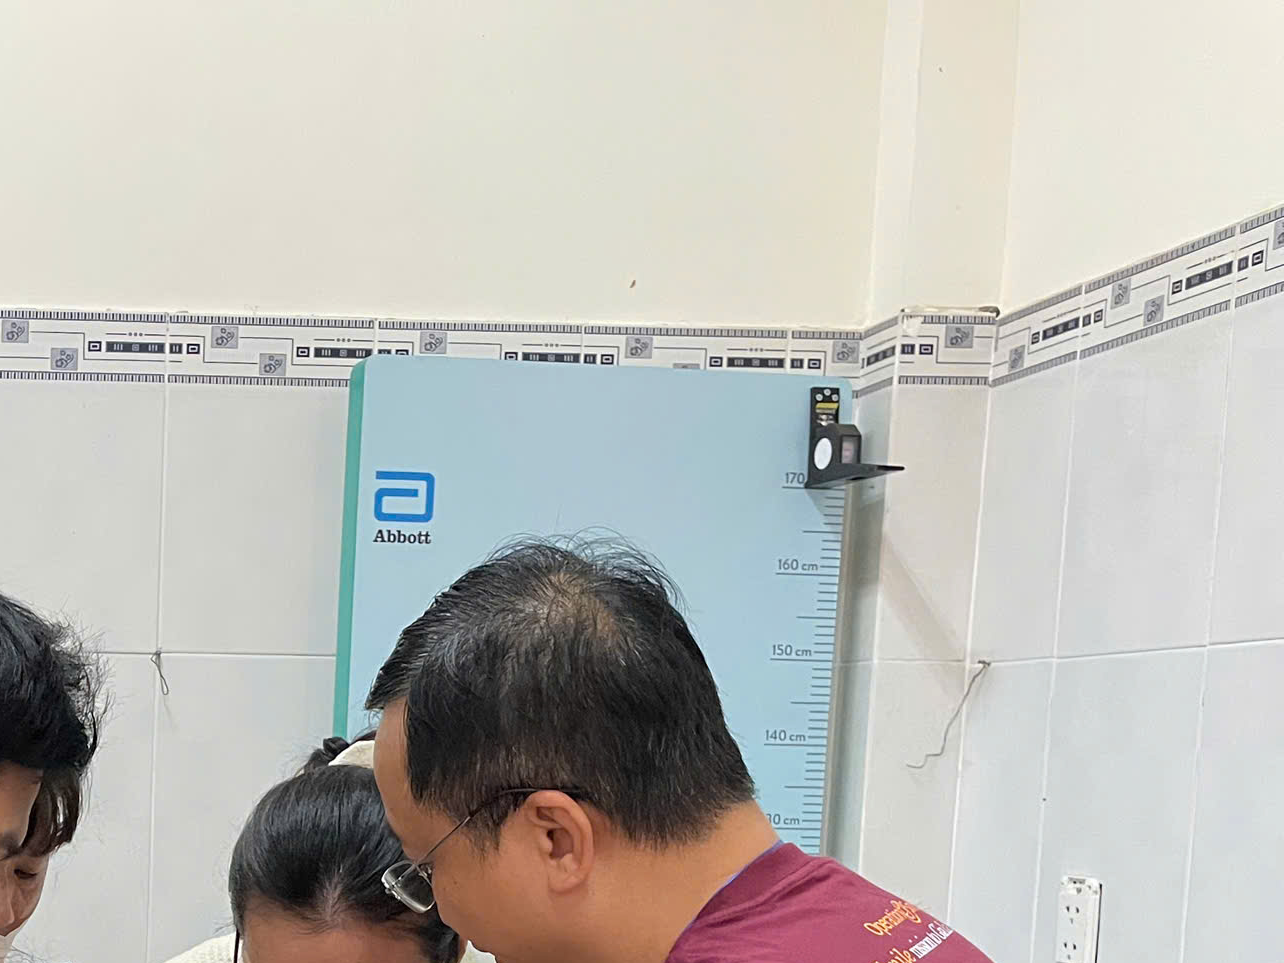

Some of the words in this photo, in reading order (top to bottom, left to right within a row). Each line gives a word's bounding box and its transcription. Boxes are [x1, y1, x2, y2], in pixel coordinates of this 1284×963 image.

[785, 472, 806, 484] 170
[373, 529, 432, 545] Abbott
[778, 558, 799, 571] 160
[801, 562, 818, 571] cm
[772, 644, 793, 656] 150
[795, 648, 812, 657] cm
[765, 729, 787, 742] 140
[789, 733, 806, 742] cm
[783, 816, 800, 826] cm
